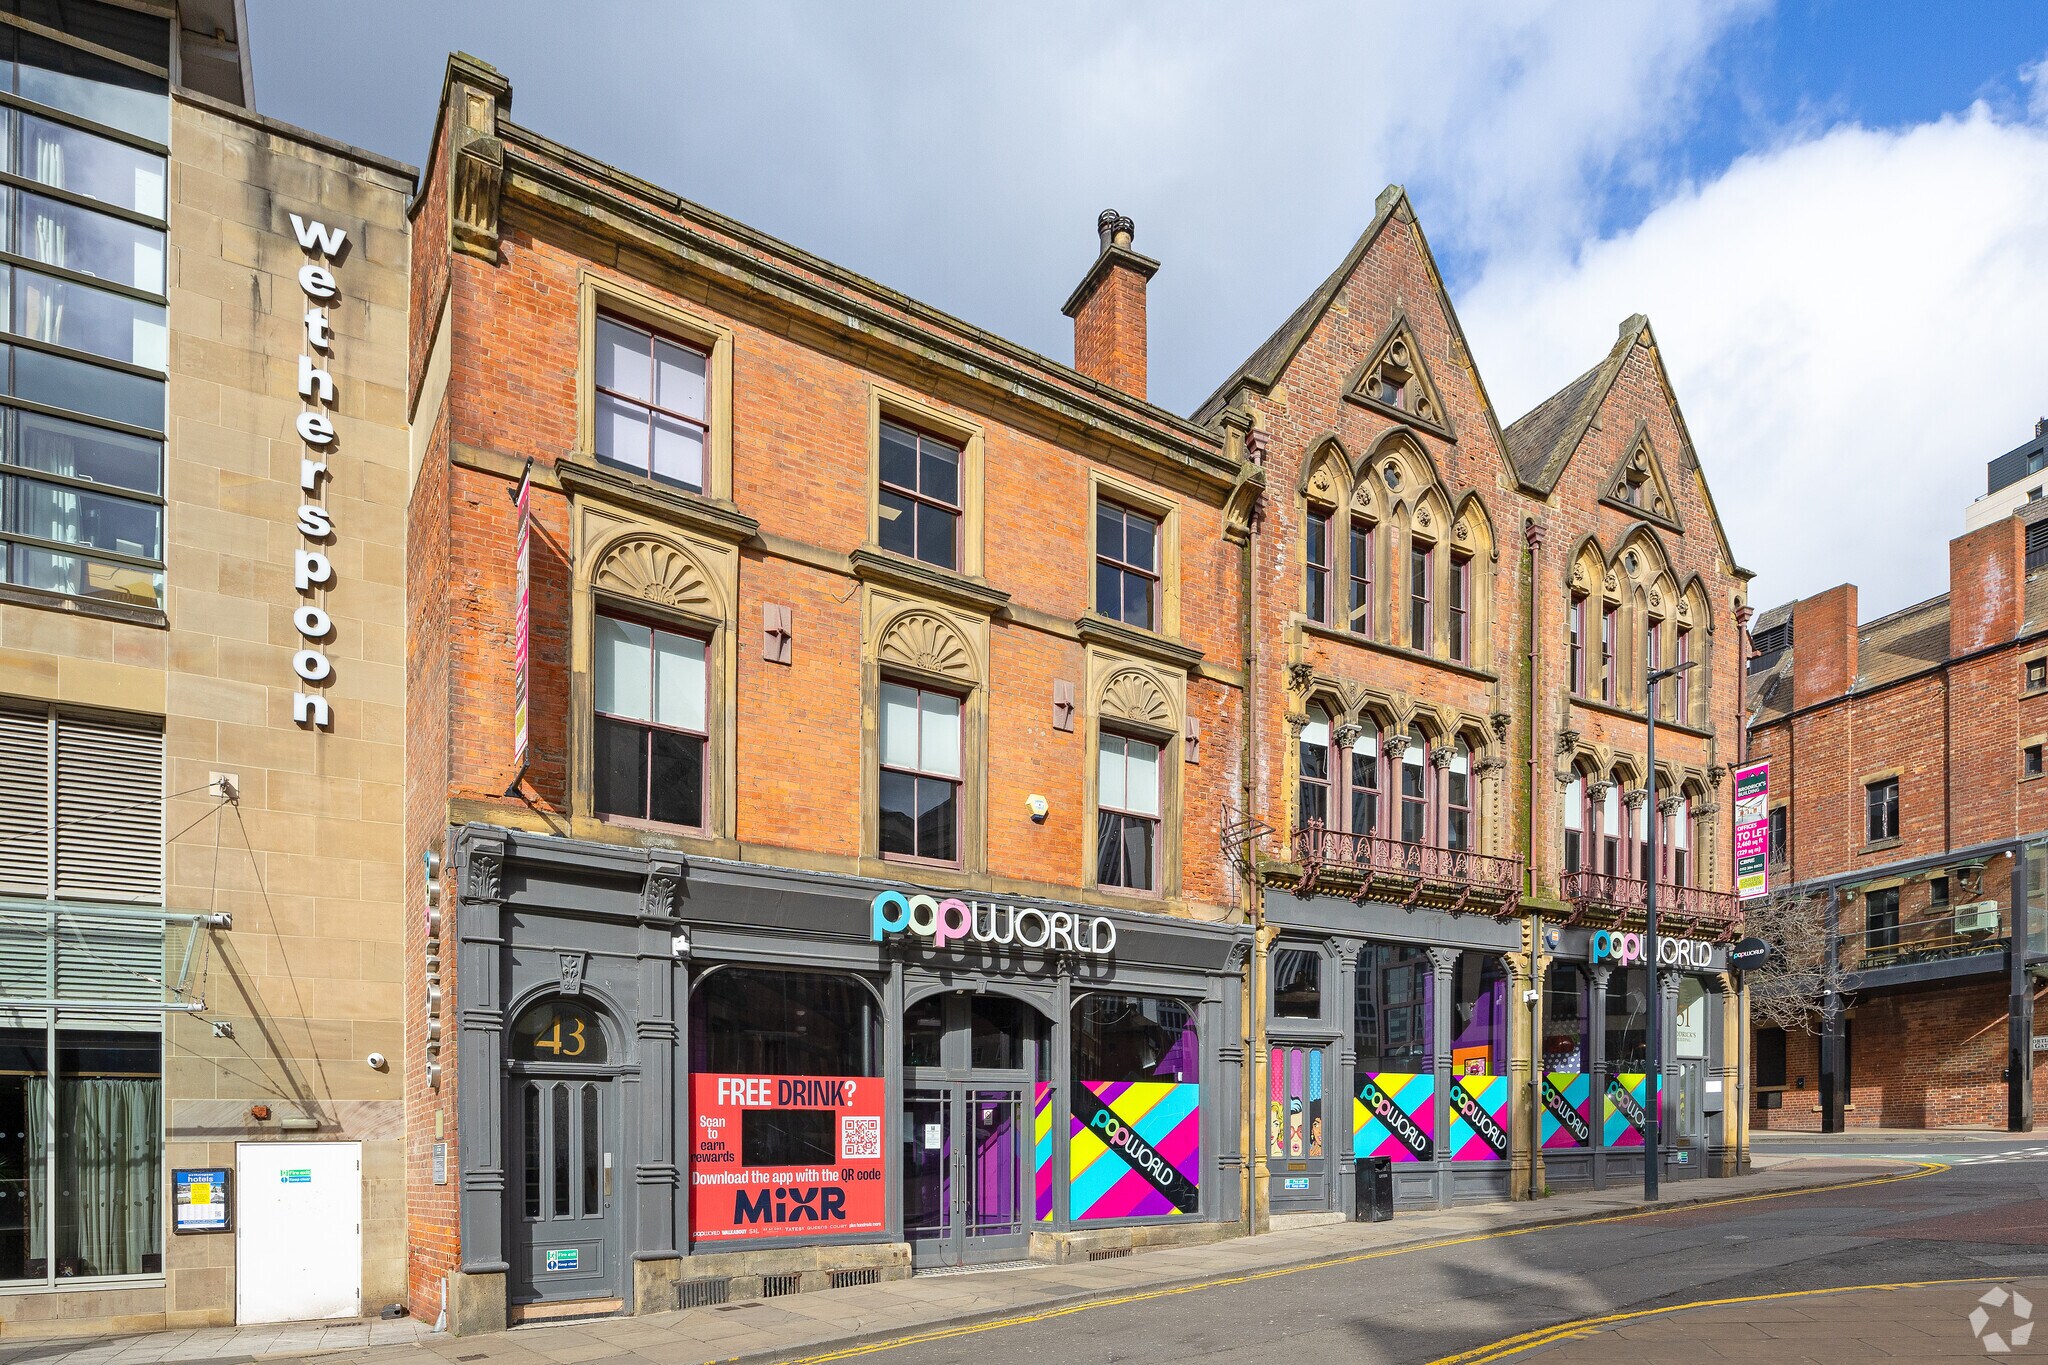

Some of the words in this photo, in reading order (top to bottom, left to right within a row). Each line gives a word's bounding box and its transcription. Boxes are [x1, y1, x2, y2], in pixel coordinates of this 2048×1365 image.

[289, 212, 348, 727] wetherspoon
[1737, 823, 1757, 831] OFFICES
[1737, 831, 1750, 841] TO
[1752, 826, 1768, 838] LET
[534, 1014, 586, 1056] 43
[717, 1078, 772, 1106] FREE
[778, 1080, 857, 1107] DRINK?
[700, 1115, 726, 1128] Scan
[707, 1127, 718, 1139] to
[700, 1140, 725, 1151] earn
[690, 1150, 735, 1163] rewards
[692, 1171, 749, 1185] Download
[751, 1169, 770, 1183] the
[772, 1171, 793, 1185] app
[794, 1169, 820, 1182] with
[821, 1168, 839, 1181] the
[841, 1169, 854, 1183] QR
[857, 1168, 881, 1181] code
[734, 1187, 846, 1224] MiXR
